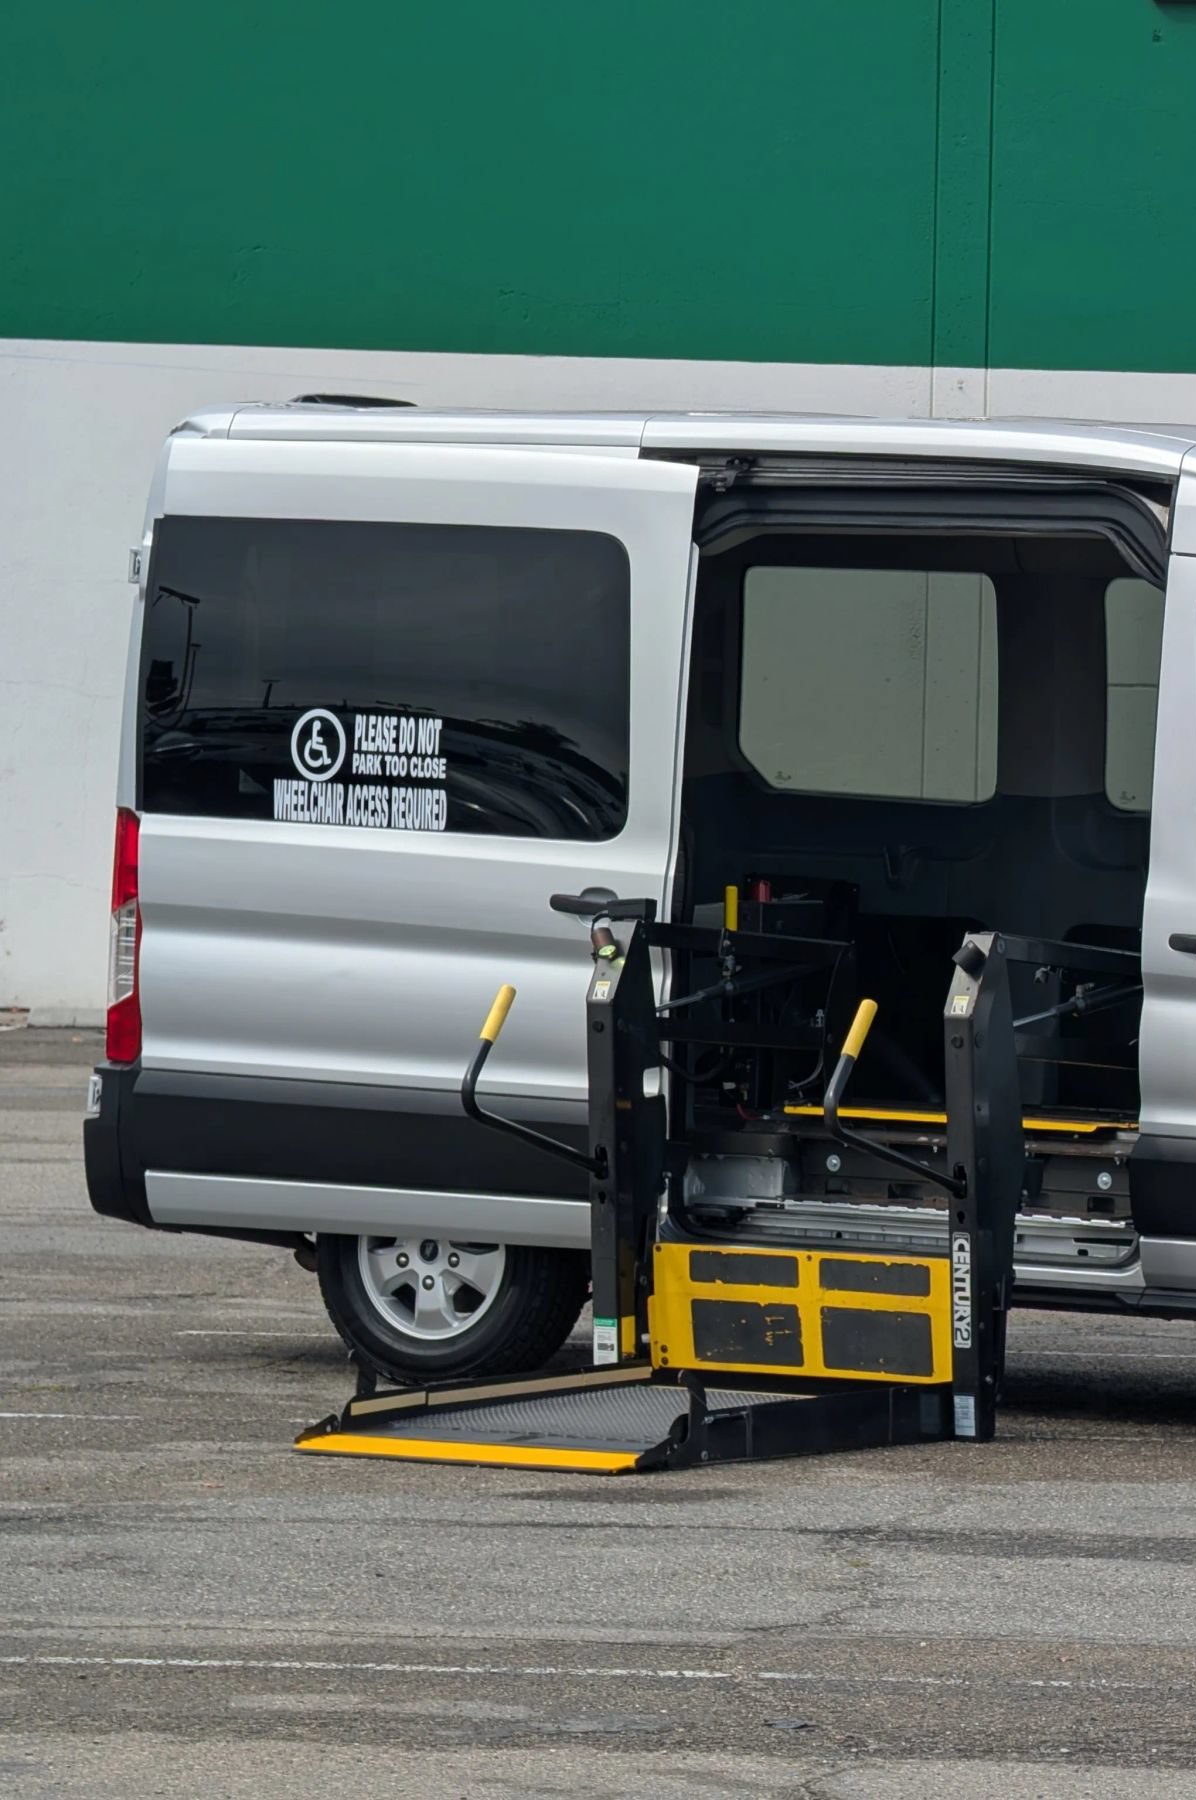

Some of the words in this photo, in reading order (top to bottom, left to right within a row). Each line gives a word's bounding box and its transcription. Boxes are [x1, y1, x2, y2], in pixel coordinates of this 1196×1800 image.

[354, 714, 398, 753] PLEASE
[399, 716, 415, 754] DO
[417, 718, 442, 756] NOT
[352, 753, 382, 776] PARK
[385, 755, 408, 777] TOO
[410, 756, 447, 779] CLOSE
[273, 778, 344, 825] WHEELCHAIR
[346, 784, 389, 828] ACCESS
[391, 786, 447, 831] REQUIRED
